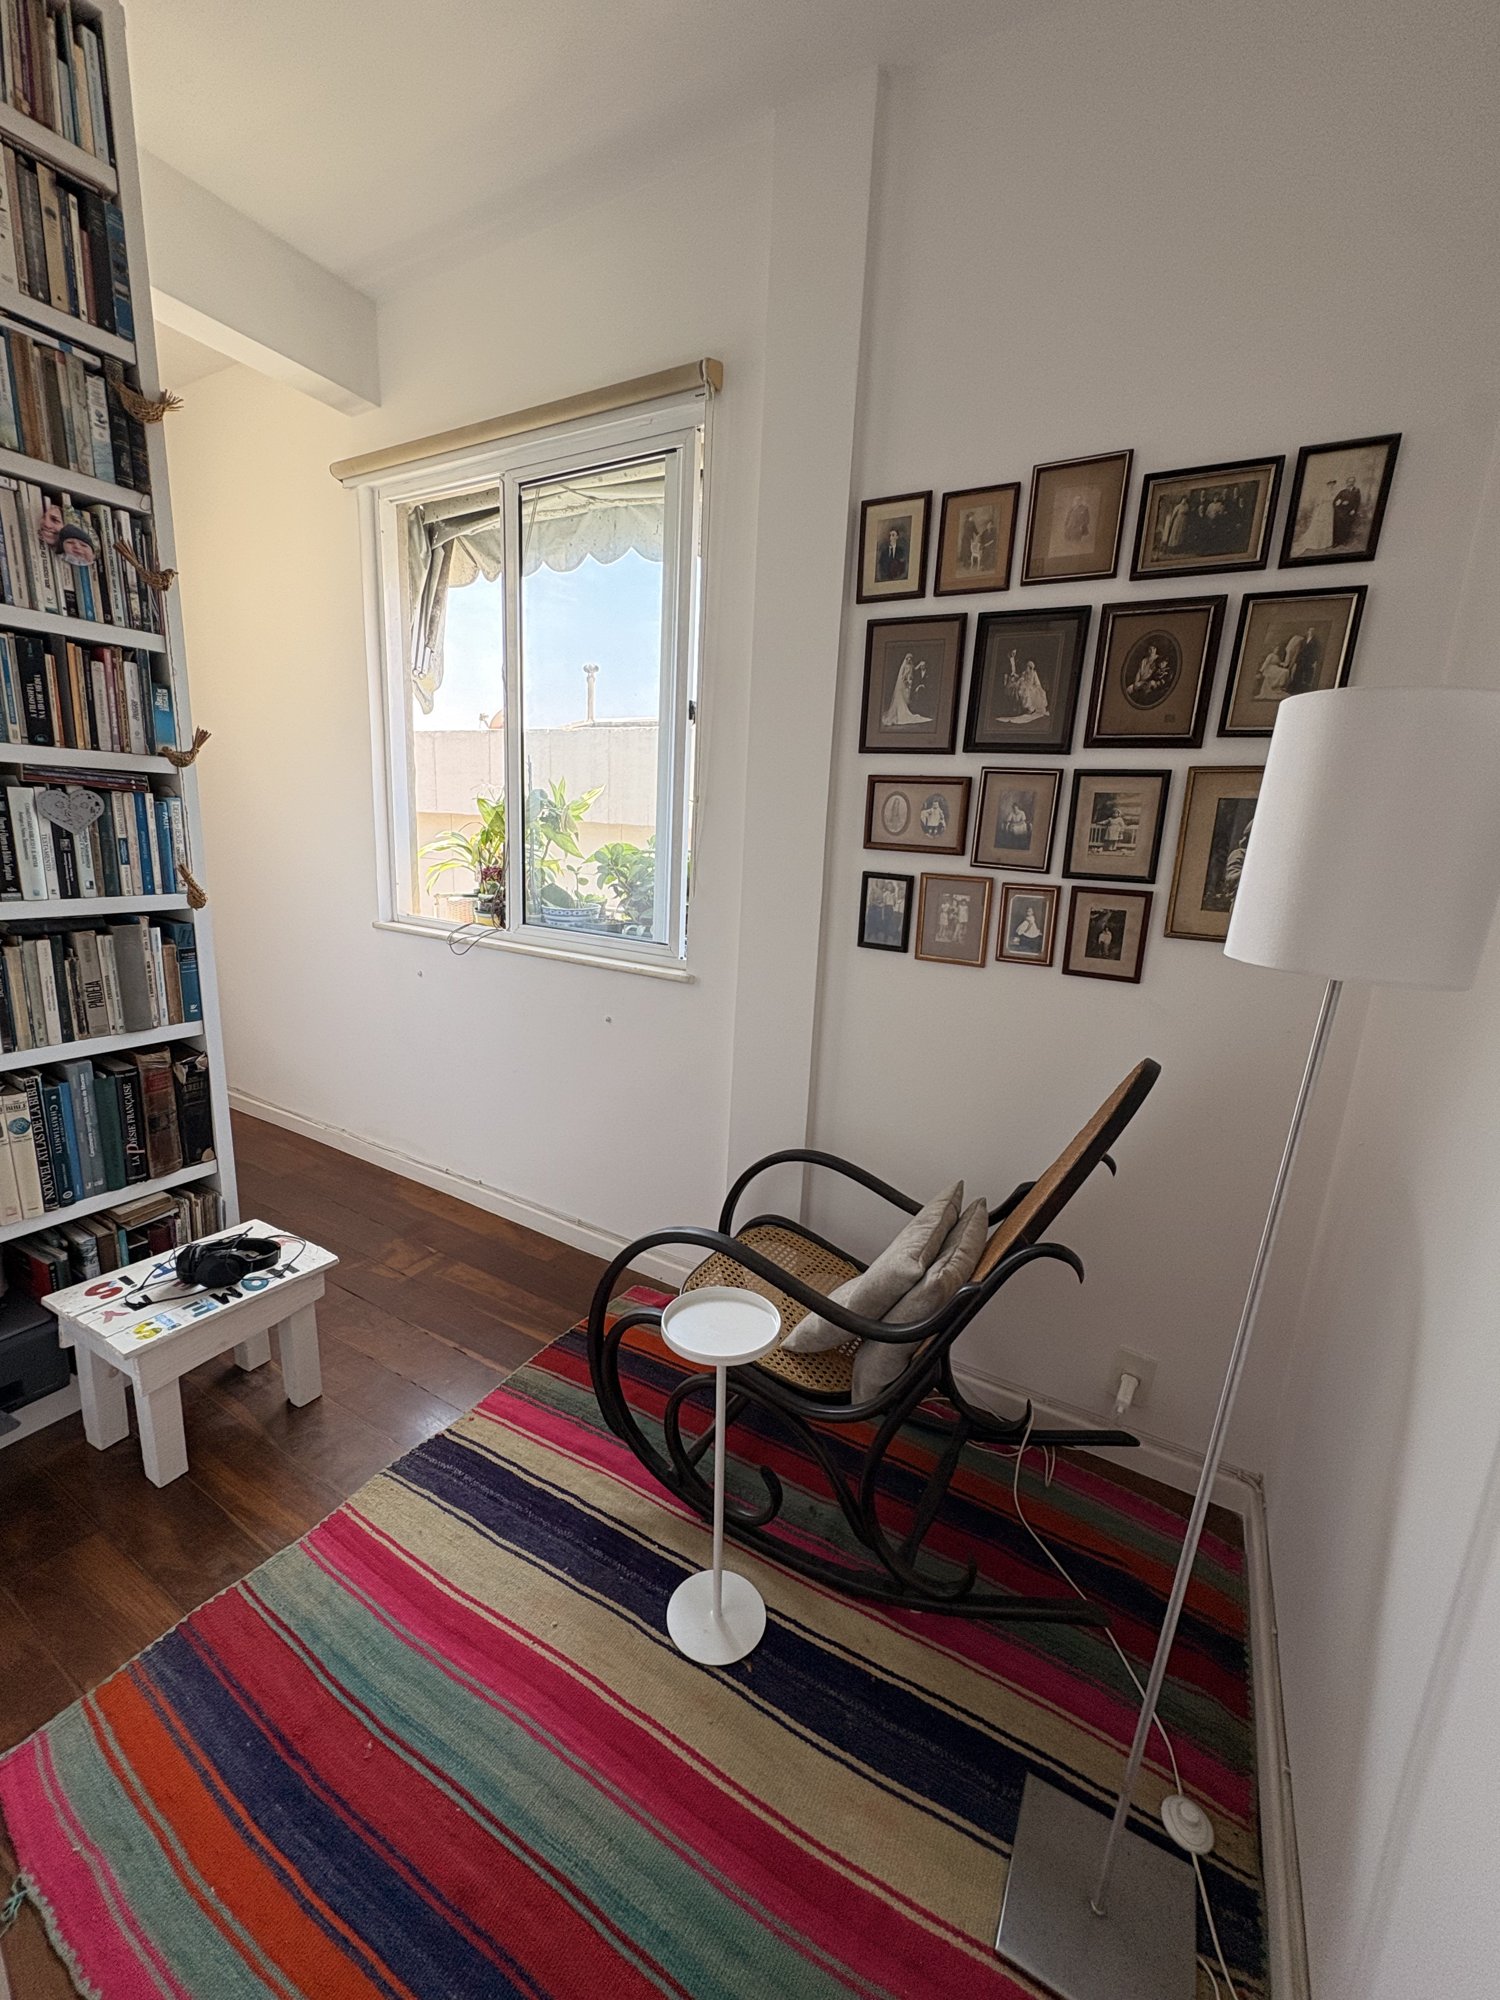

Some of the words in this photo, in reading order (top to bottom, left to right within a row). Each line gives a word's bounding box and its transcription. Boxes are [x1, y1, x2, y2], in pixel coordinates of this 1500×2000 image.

[172, 803, 181, 824] DEPOIS
[39, 833, 53, 872] TESTAMENTO
[25, 1077, 40, 1105] BIBLE
[122, 1082, 136, 1123] FRANÇAISE
[29, 1103, 42, 1119] LA
[31, 1118, 45, 1132] DE
[48, 1104, 64, 1153] CHRISTIANITY
[124, 1122, 145, 1155] POÉSIE
[34, 1132, 49, 1161] ATLAS
[130, 1155, 140, 1165] LA
[38, 1161, 55, 1199] NOUVEL
